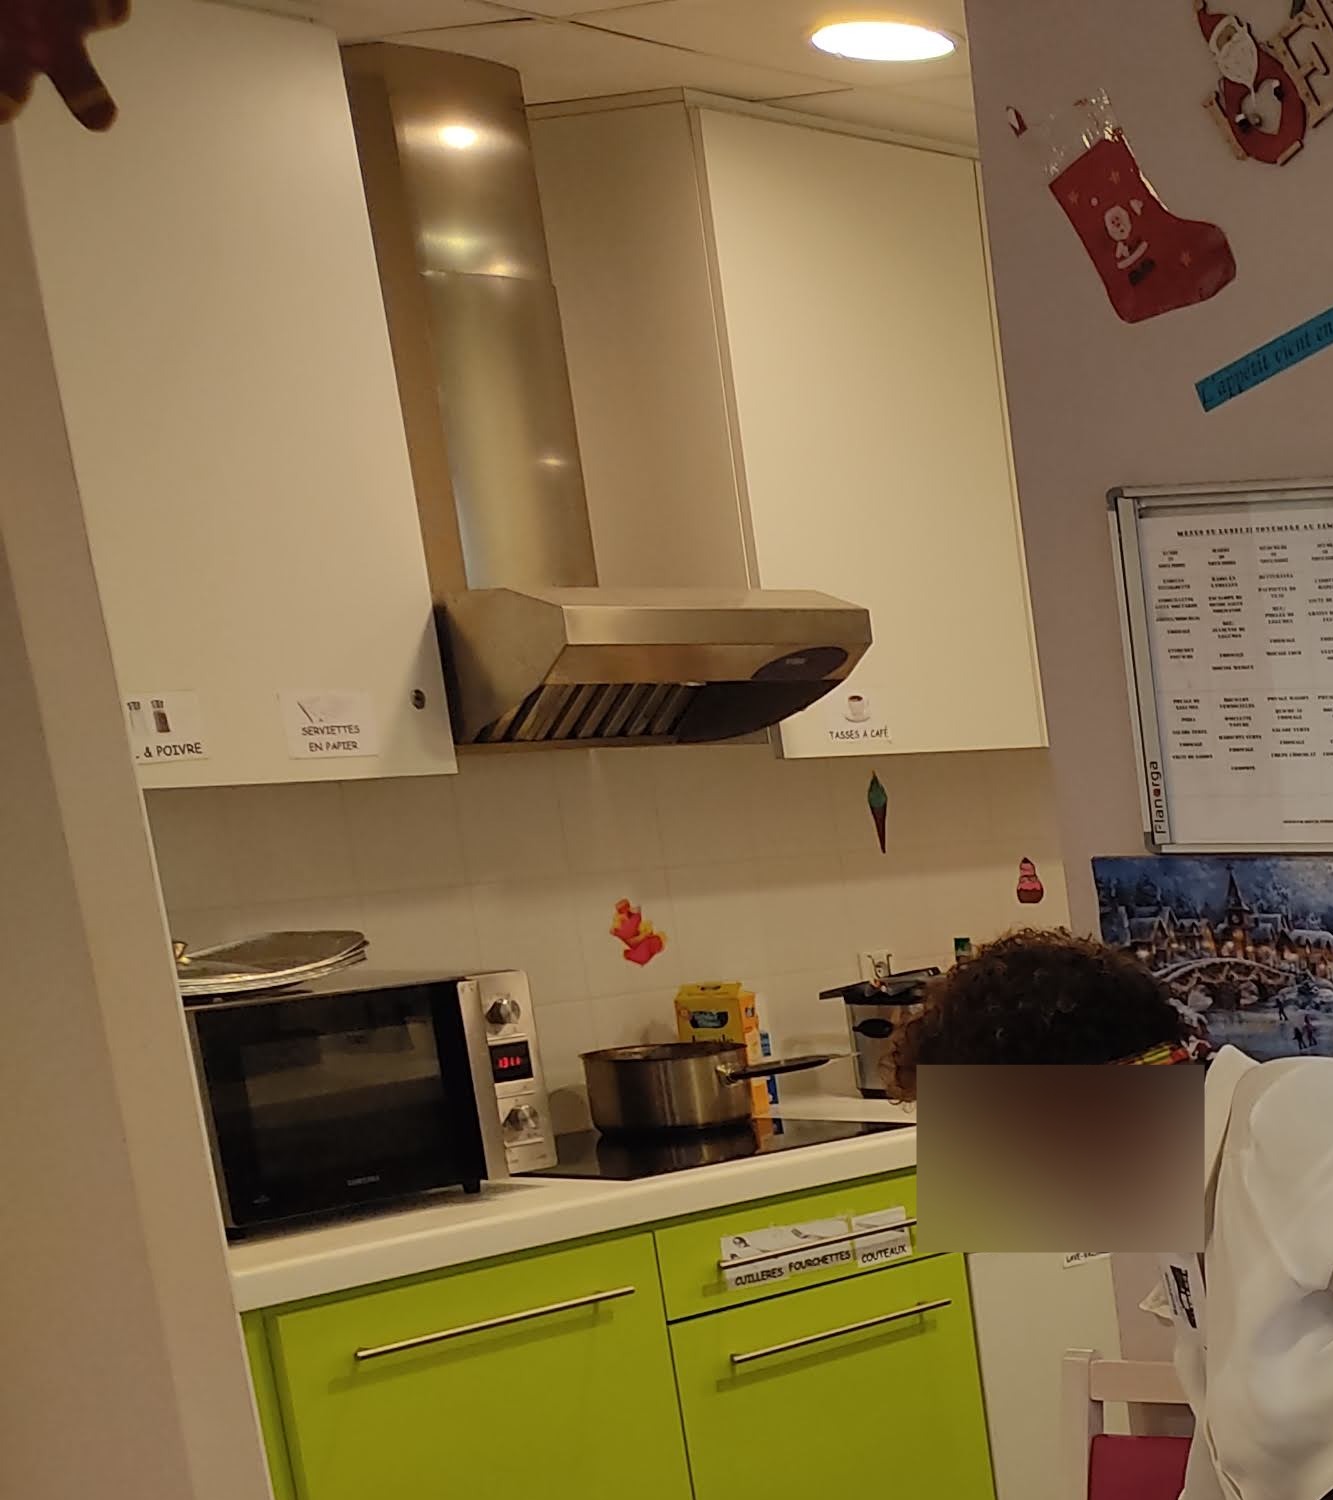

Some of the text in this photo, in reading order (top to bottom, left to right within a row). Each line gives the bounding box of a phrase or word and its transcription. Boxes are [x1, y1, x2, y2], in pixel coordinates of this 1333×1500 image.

[1273, 332, 1313, 367] vient
[301, 724, 360, 736] SERVIETTES
[829, 729, 860, 741] TASSES
[155, 742, 203, 757] POIVRE
[308, 740, 359, 752] EN PAPIER
[788, 1250, 852, 1273] FOURCHETTES
[861, 1243, 908, 1265] COUTEAUX
